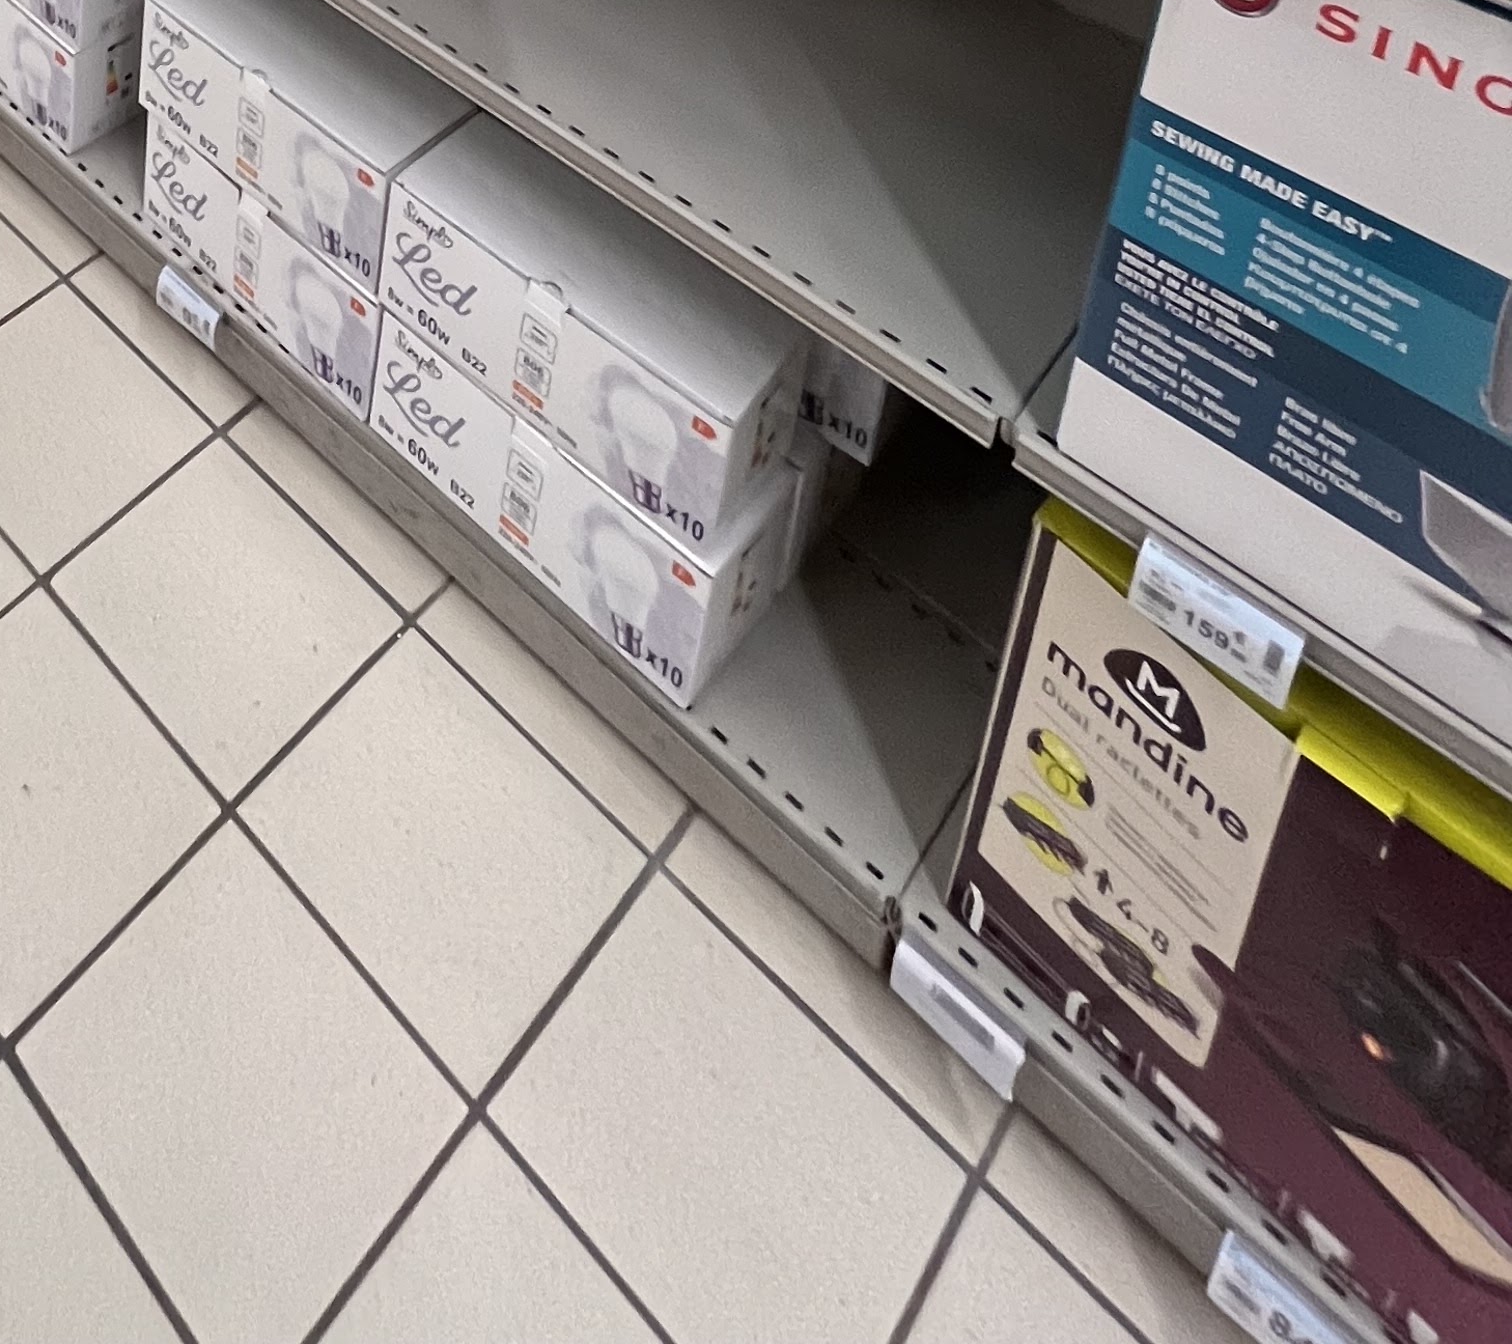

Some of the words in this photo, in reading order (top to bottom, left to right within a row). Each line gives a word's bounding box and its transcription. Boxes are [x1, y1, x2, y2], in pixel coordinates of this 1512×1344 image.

[148, 39, 208, 107] Led
[151, 152, 208, 221] Led
[1151, 119, 1235, 173] SEWING
[1240, 164, 1307, 209] MADE
[344, 246, 371, 278] x10
[391, 231, 478, 317] Led
[417, 309, 451, 346] 60w
[461, 347, 487, 377] B22
[336, 372, 362, 405] x10
[383, 360, 466, 449] Led
[828, 413, 867, 449] x10
[408, 437, 439, 476] 60w
[450, 479, 475, 510] B22
[666, 501, 705, 542] x10
[1184, 610, 1229, 650] 159
[646, 647, 684, 689] x10
[1047, 640, 1249, 844] mandine
